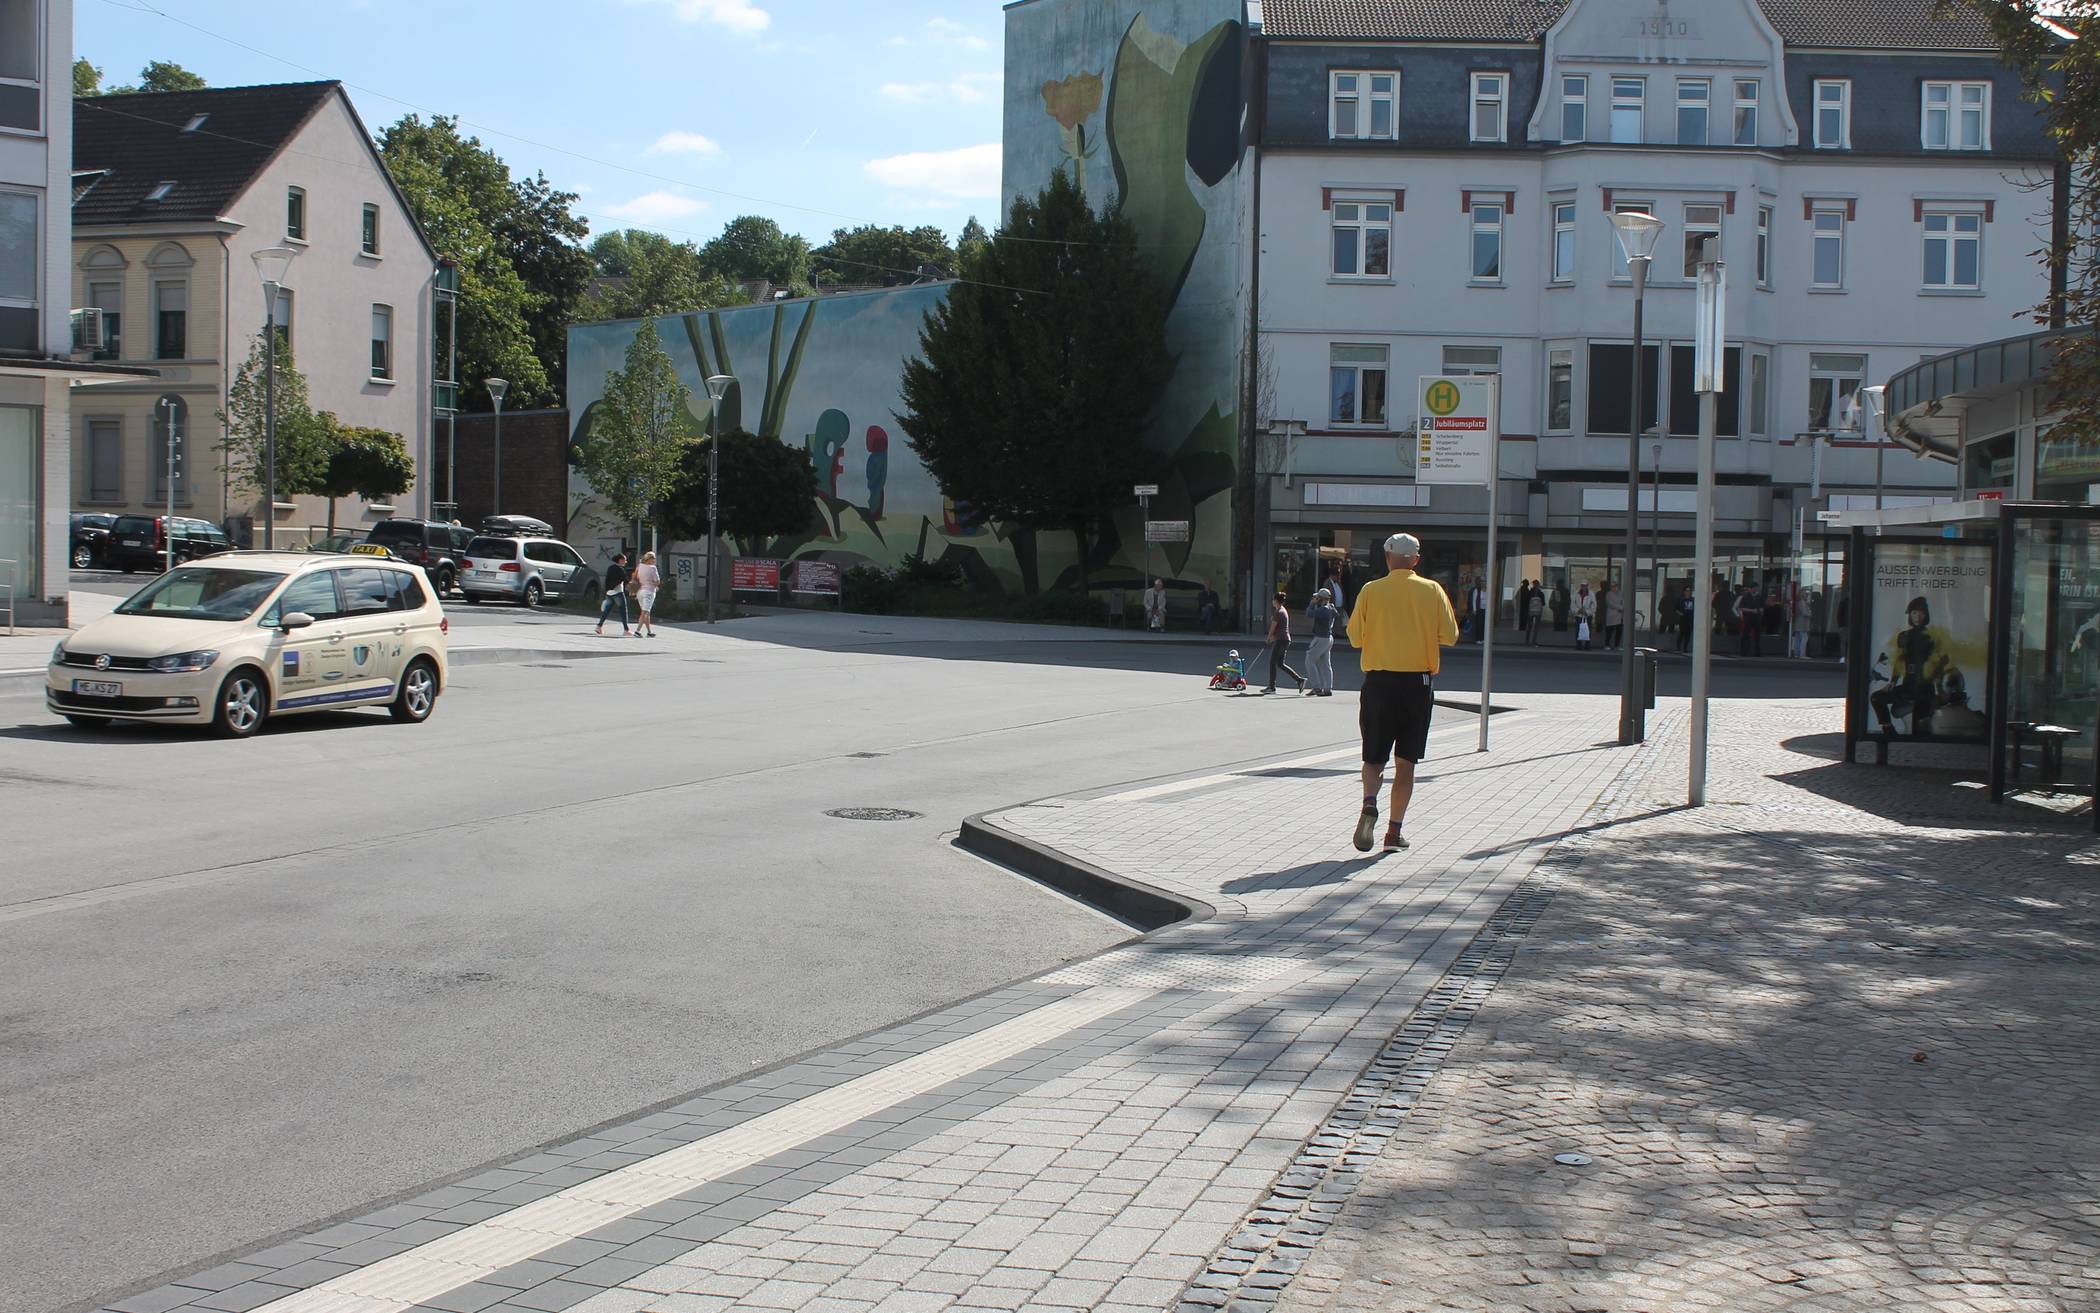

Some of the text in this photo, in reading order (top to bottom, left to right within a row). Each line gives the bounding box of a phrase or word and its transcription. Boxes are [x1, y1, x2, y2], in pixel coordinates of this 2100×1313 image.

[1640, 21, 1688, 36] 1910
[1424, 419, 1485, 429] 2 Jubiläumsplatz
[354, 545, 375, 553] TAXI
[1876, 565, 1986, 577] AUSSENWERBUNG
[1877, 578, 1918, 589] TRIFFT.
[107, 683, 118, 694] 27
